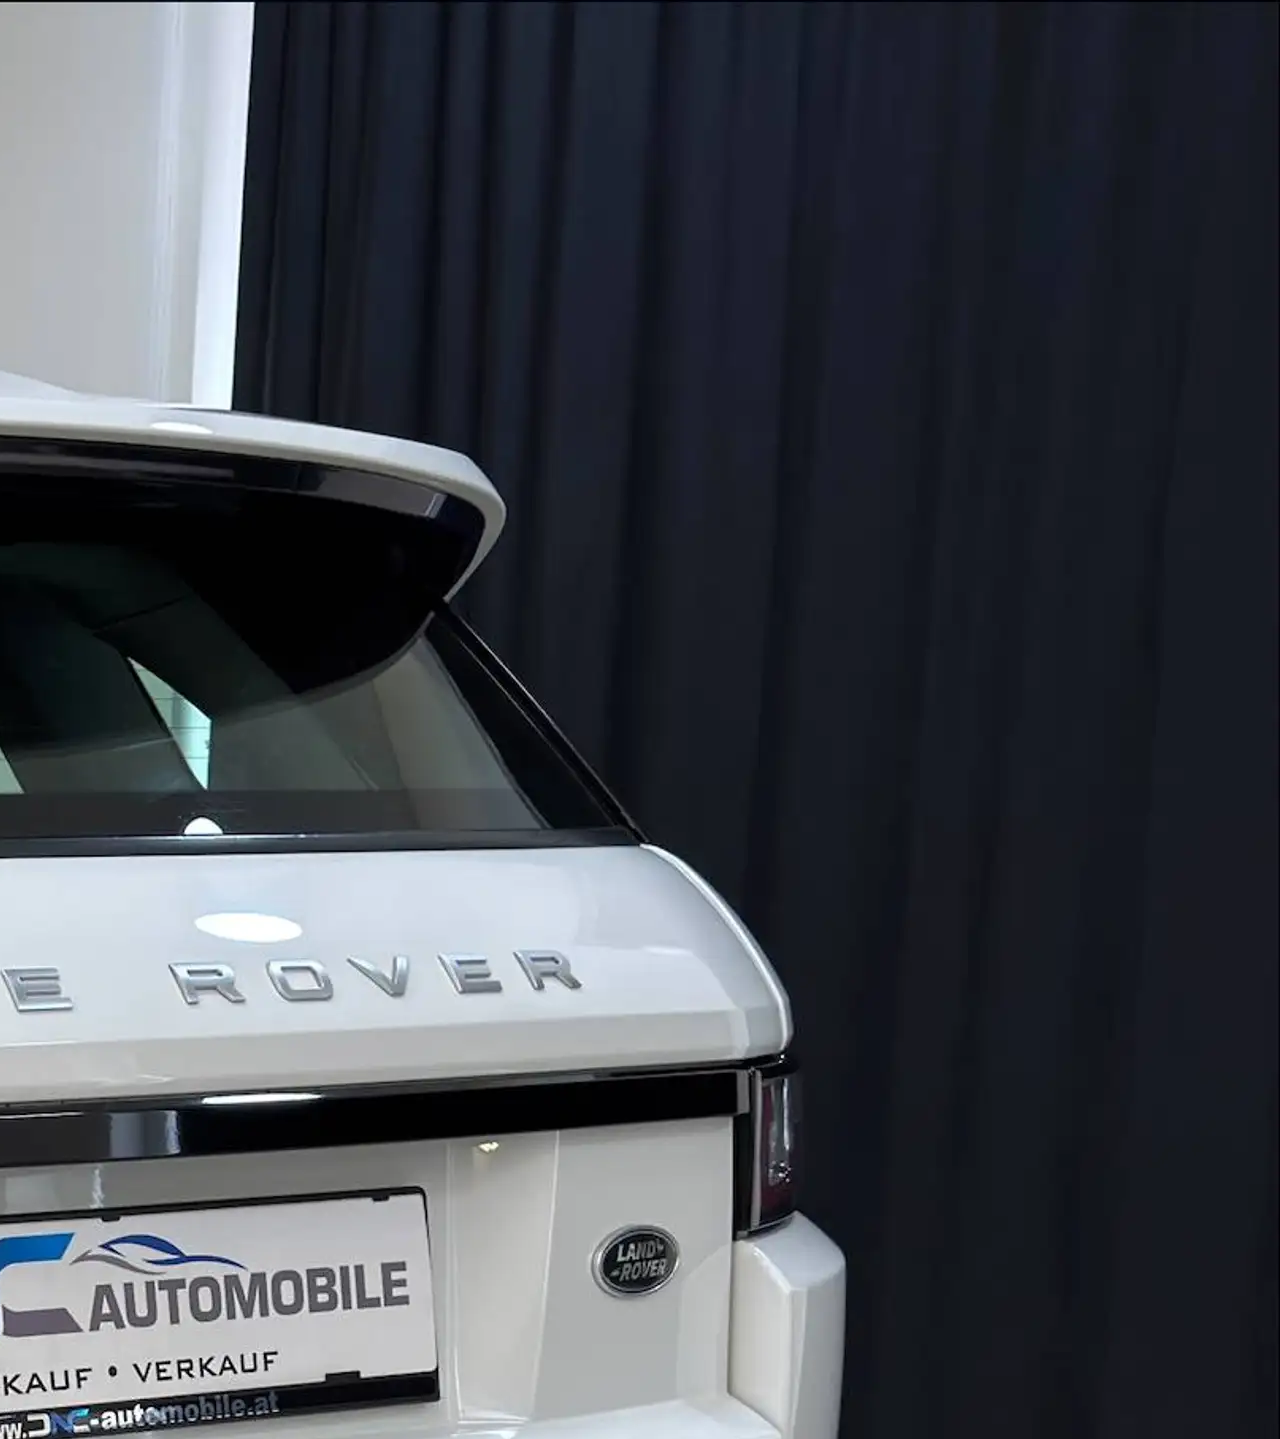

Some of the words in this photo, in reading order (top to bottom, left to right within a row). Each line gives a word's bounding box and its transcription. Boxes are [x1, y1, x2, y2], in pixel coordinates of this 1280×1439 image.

[167, 949, 583, 1004] ROVER
[616, 1240, 657, 1262] LAND
[620, 1259, 667, 1281] ROVER
[88, 1260, 411, 1332] AUTOMOBILE
[133, 1350, 280, 1383] VERKAUF
